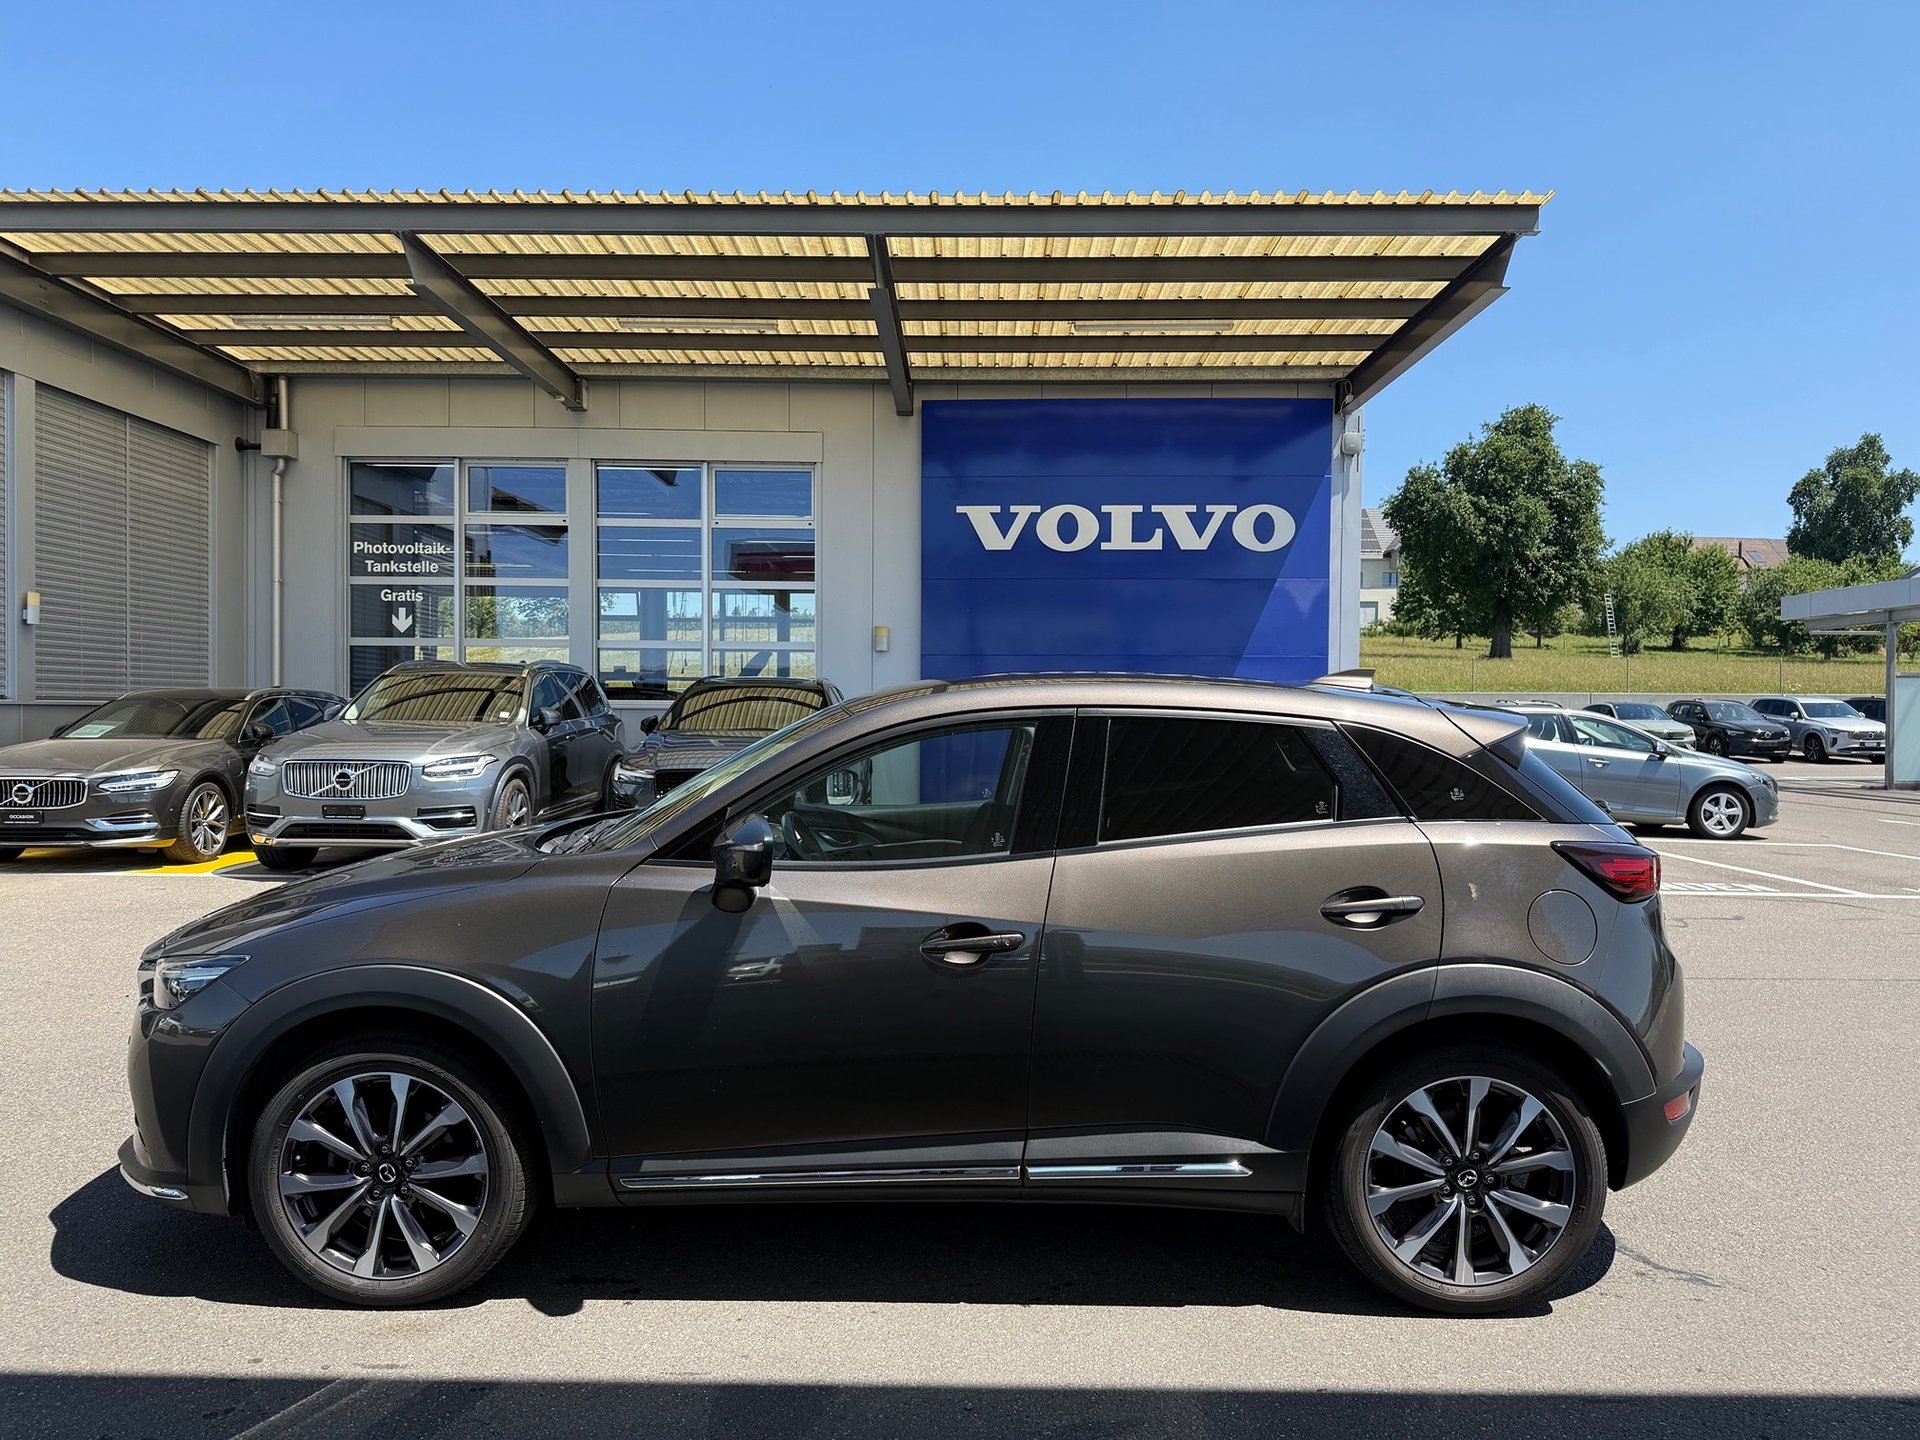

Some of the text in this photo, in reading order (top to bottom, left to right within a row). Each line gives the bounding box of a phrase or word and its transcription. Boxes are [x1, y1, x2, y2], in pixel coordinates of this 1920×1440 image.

[956, 504, 1296, 552] VOLVO
[353, 541, 451, 554] Photovoltaik-
[365, 560, 439, 573] Tankstelle
[380, 589, 424, 602] Gratis
